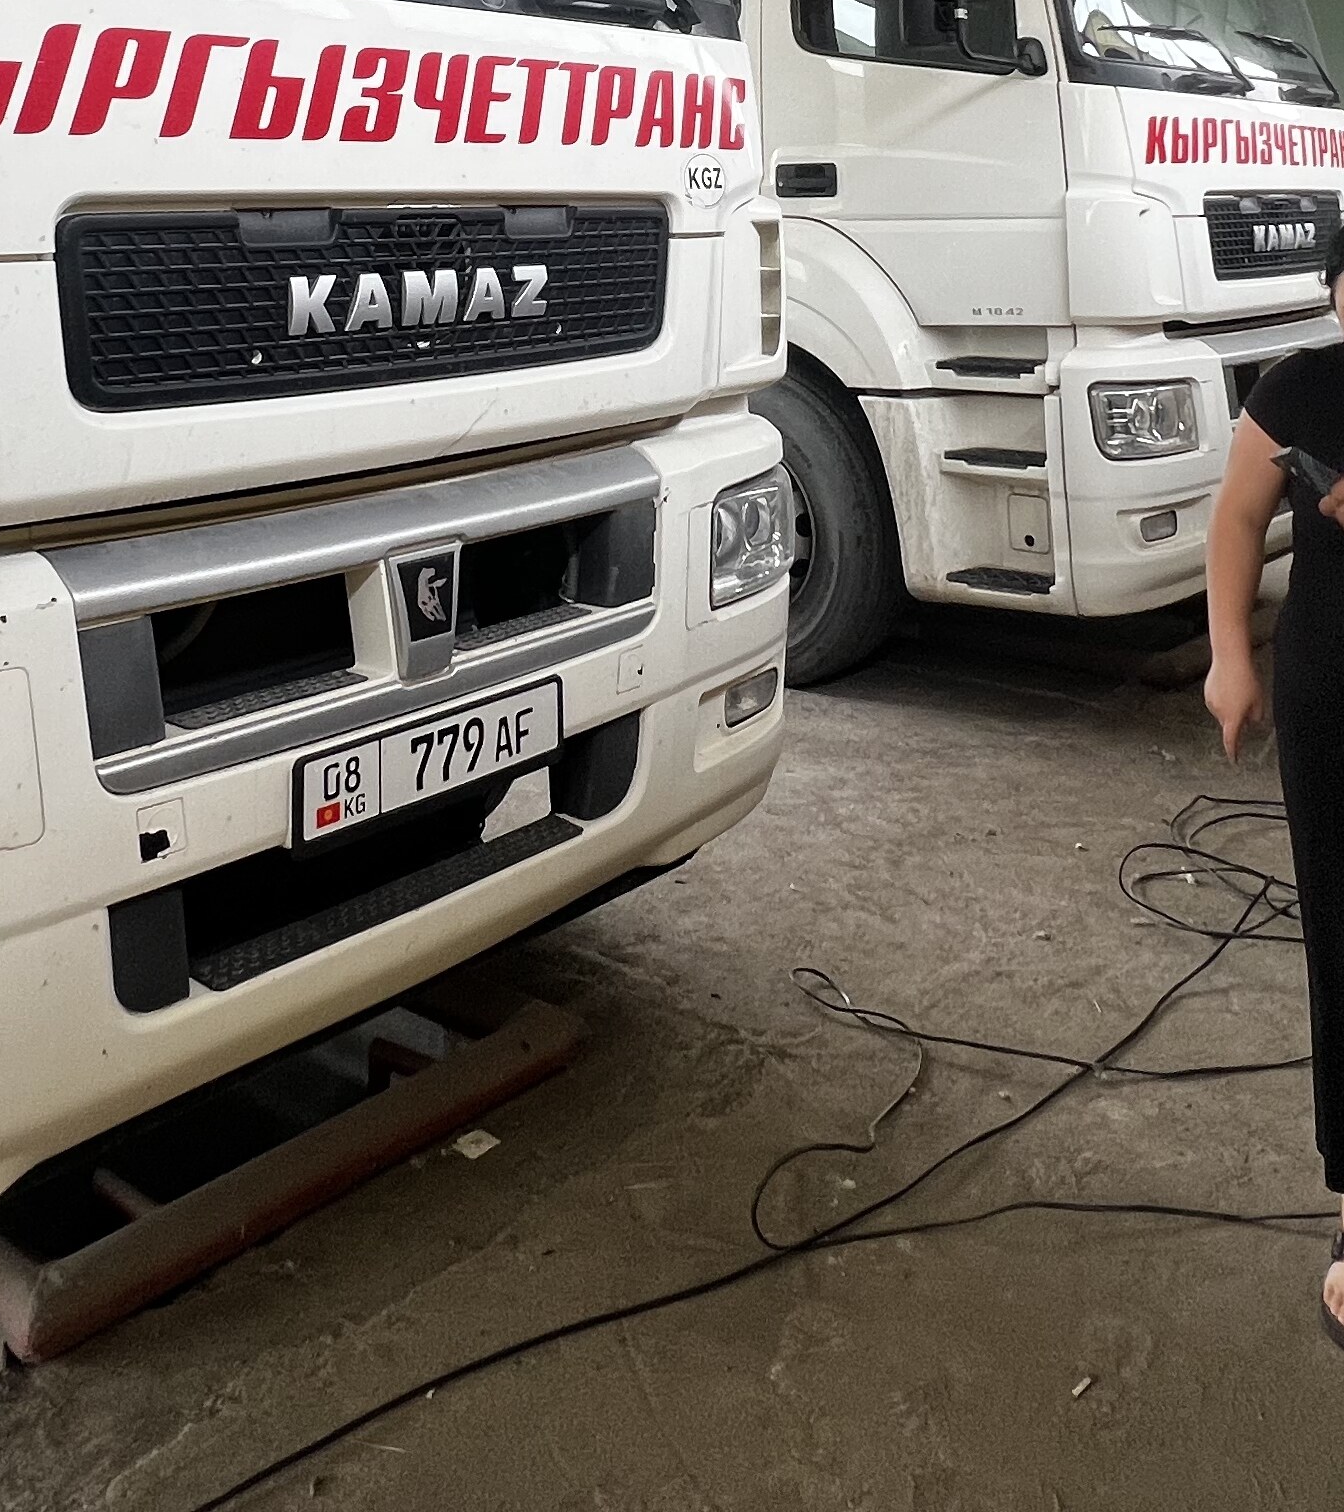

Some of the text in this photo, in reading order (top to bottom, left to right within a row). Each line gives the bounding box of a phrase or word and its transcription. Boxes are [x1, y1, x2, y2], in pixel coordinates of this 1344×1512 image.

[688, 167, 723, 190] KGZ
[287, 264, 552, 339] KAMAZ
[323, 706, 534, 801] 08 779 AF
[344, 792, 366, 820] KG
